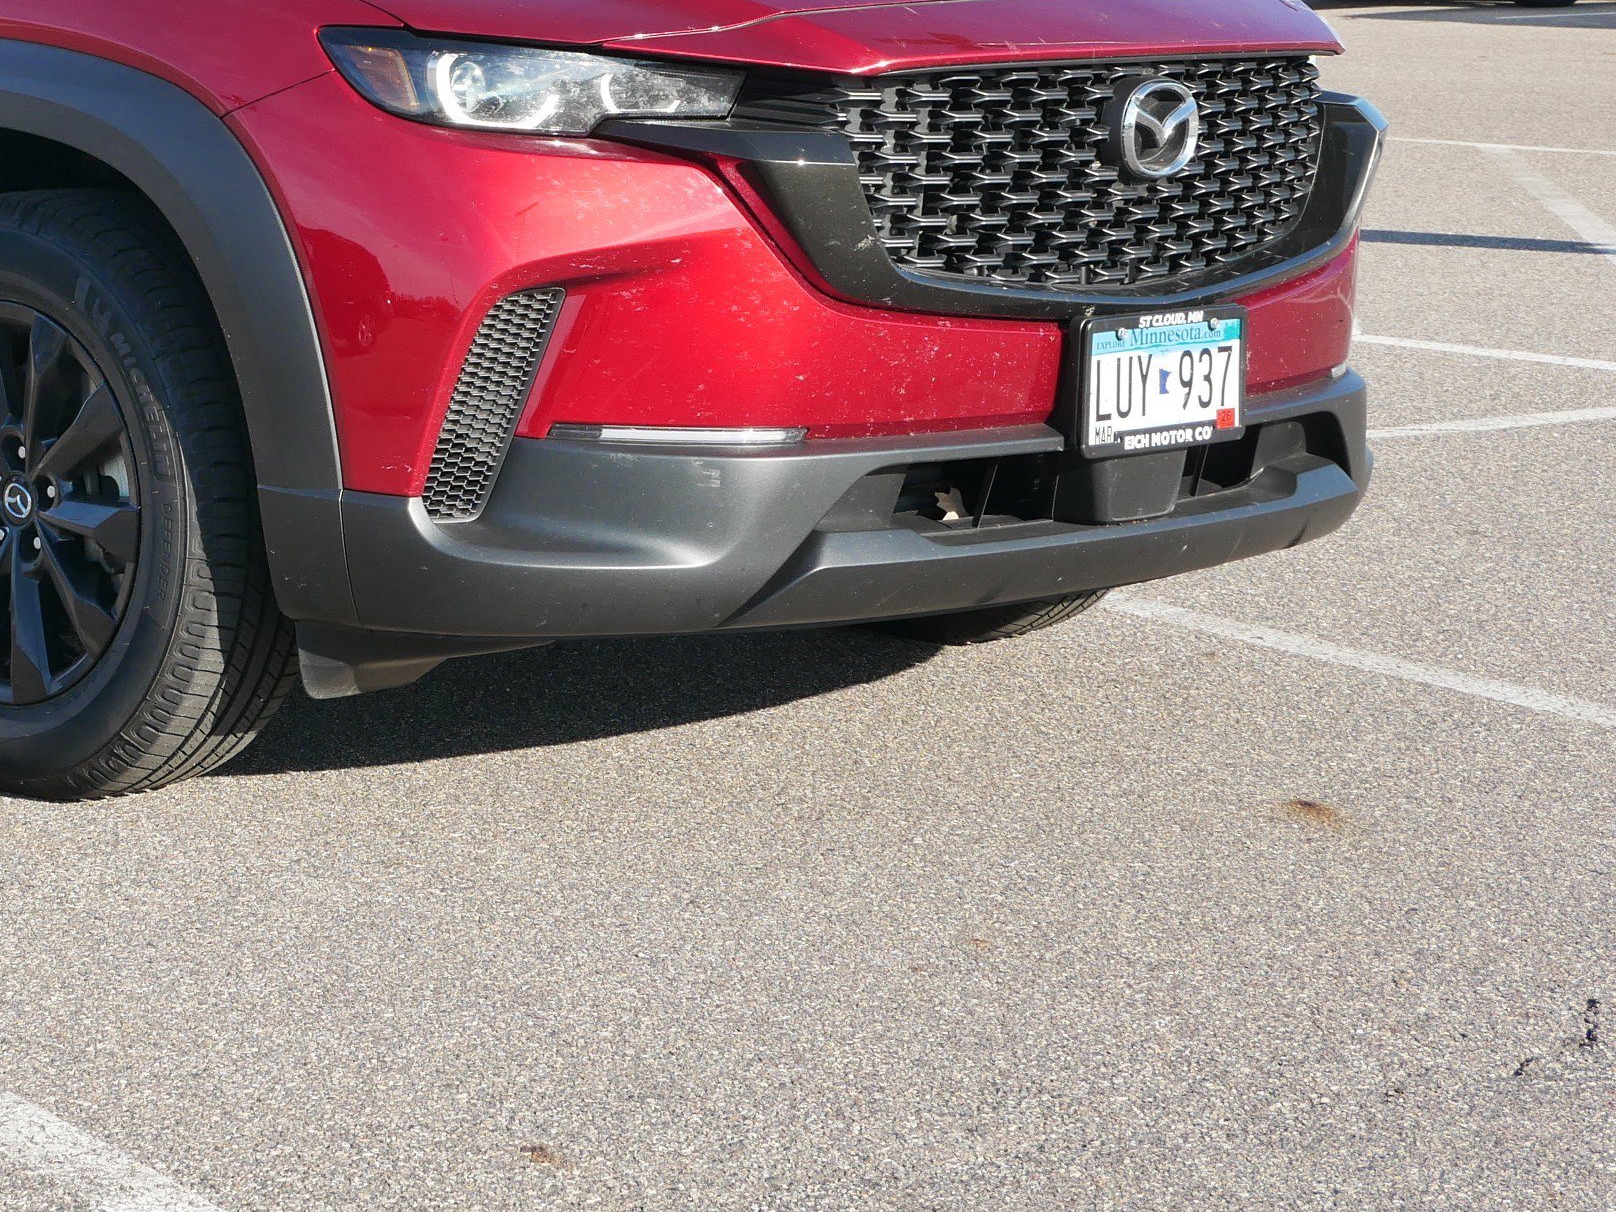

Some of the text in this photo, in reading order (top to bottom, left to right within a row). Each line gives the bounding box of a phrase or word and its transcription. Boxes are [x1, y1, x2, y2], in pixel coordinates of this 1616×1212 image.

[1187, 310, 1204, 323] MN
[1095, 345, 1233, 422] LUY 937
[1220, 410, 1232, 422] 26
[1151, 428, 1194, 447] MOTOR
